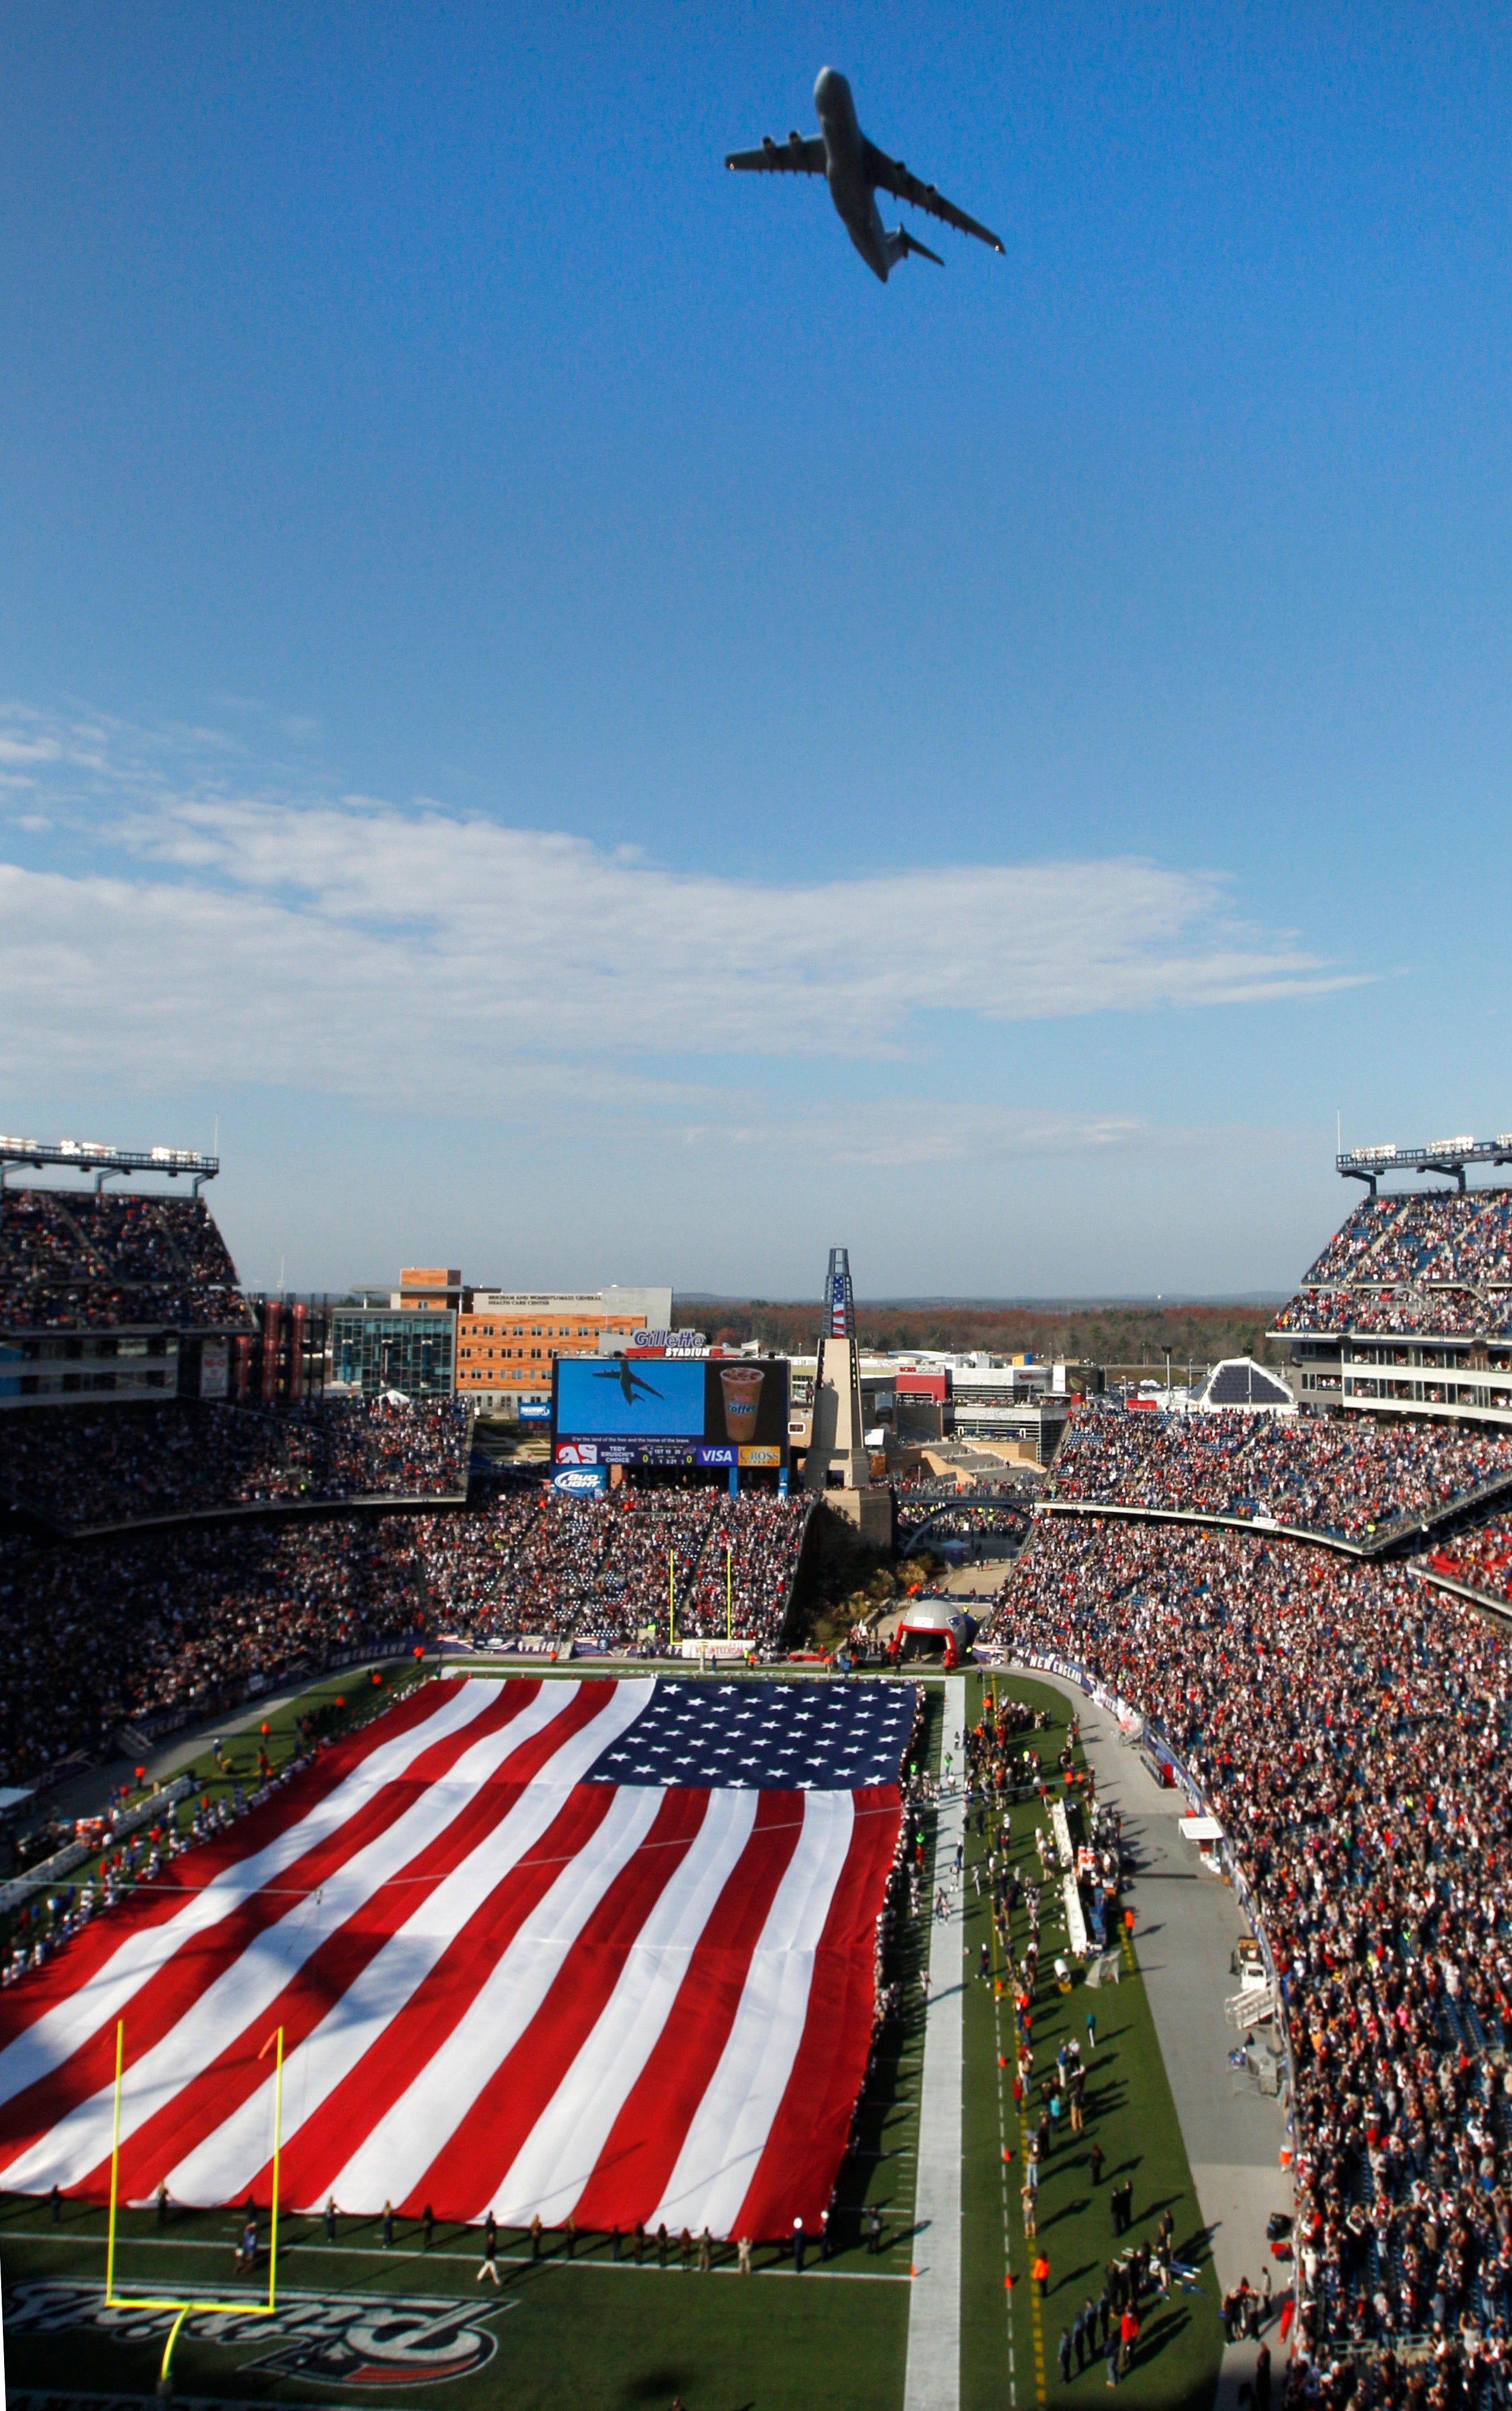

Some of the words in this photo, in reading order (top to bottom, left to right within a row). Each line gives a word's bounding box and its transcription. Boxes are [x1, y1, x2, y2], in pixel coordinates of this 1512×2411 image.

[634, 1329, 706, 1347] Gillette
[665, 1347, 710, 1357] STADIUM
[643, 1455, 649, 1463] 0
[686, 1455, 692, 1463] 0
[702, 1450, 732, 1461] VISA
[1029, 1655, 1054, 1671] NEW
[1052, 1661, 1082, 1684] ENGLAND
